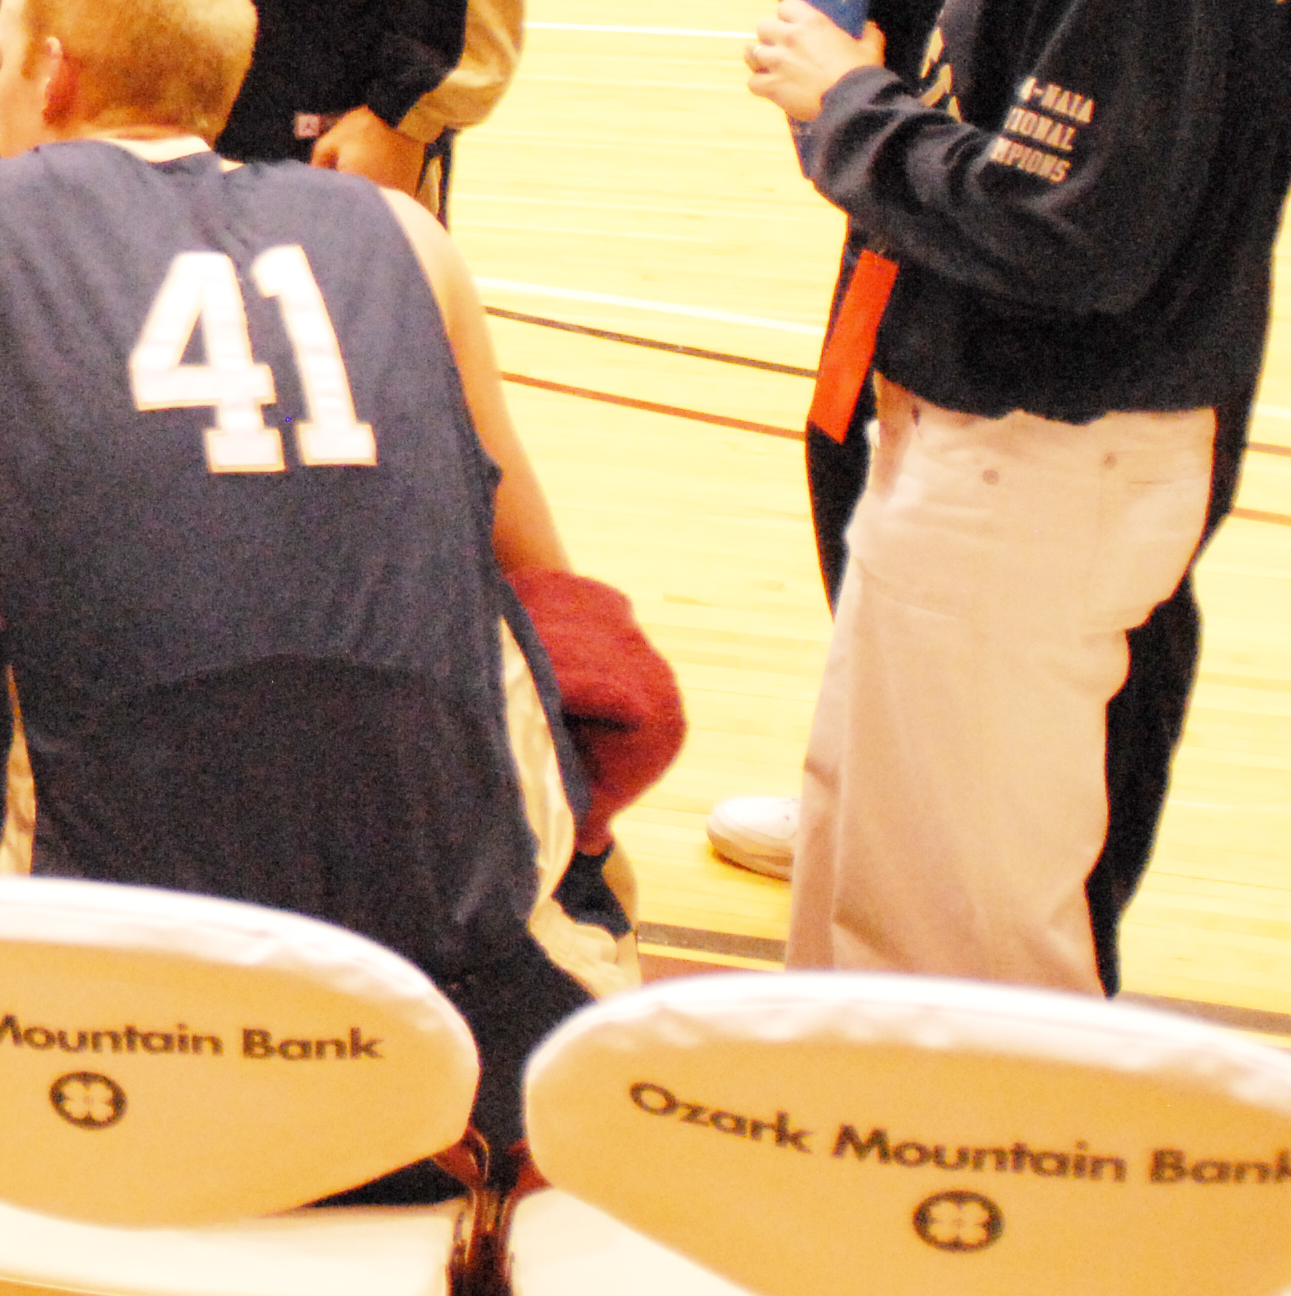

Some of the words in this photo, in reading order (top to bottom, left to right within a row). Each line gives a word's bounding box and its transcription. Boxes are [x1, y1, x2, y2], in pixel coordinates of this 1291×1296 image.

[127, 241, 379, 476] 41
[240, 1021, 386, 1063] Bank
[630, 1080, 814, 1156] Ozark
[830, 1121, 1127, 1186] Mountain
